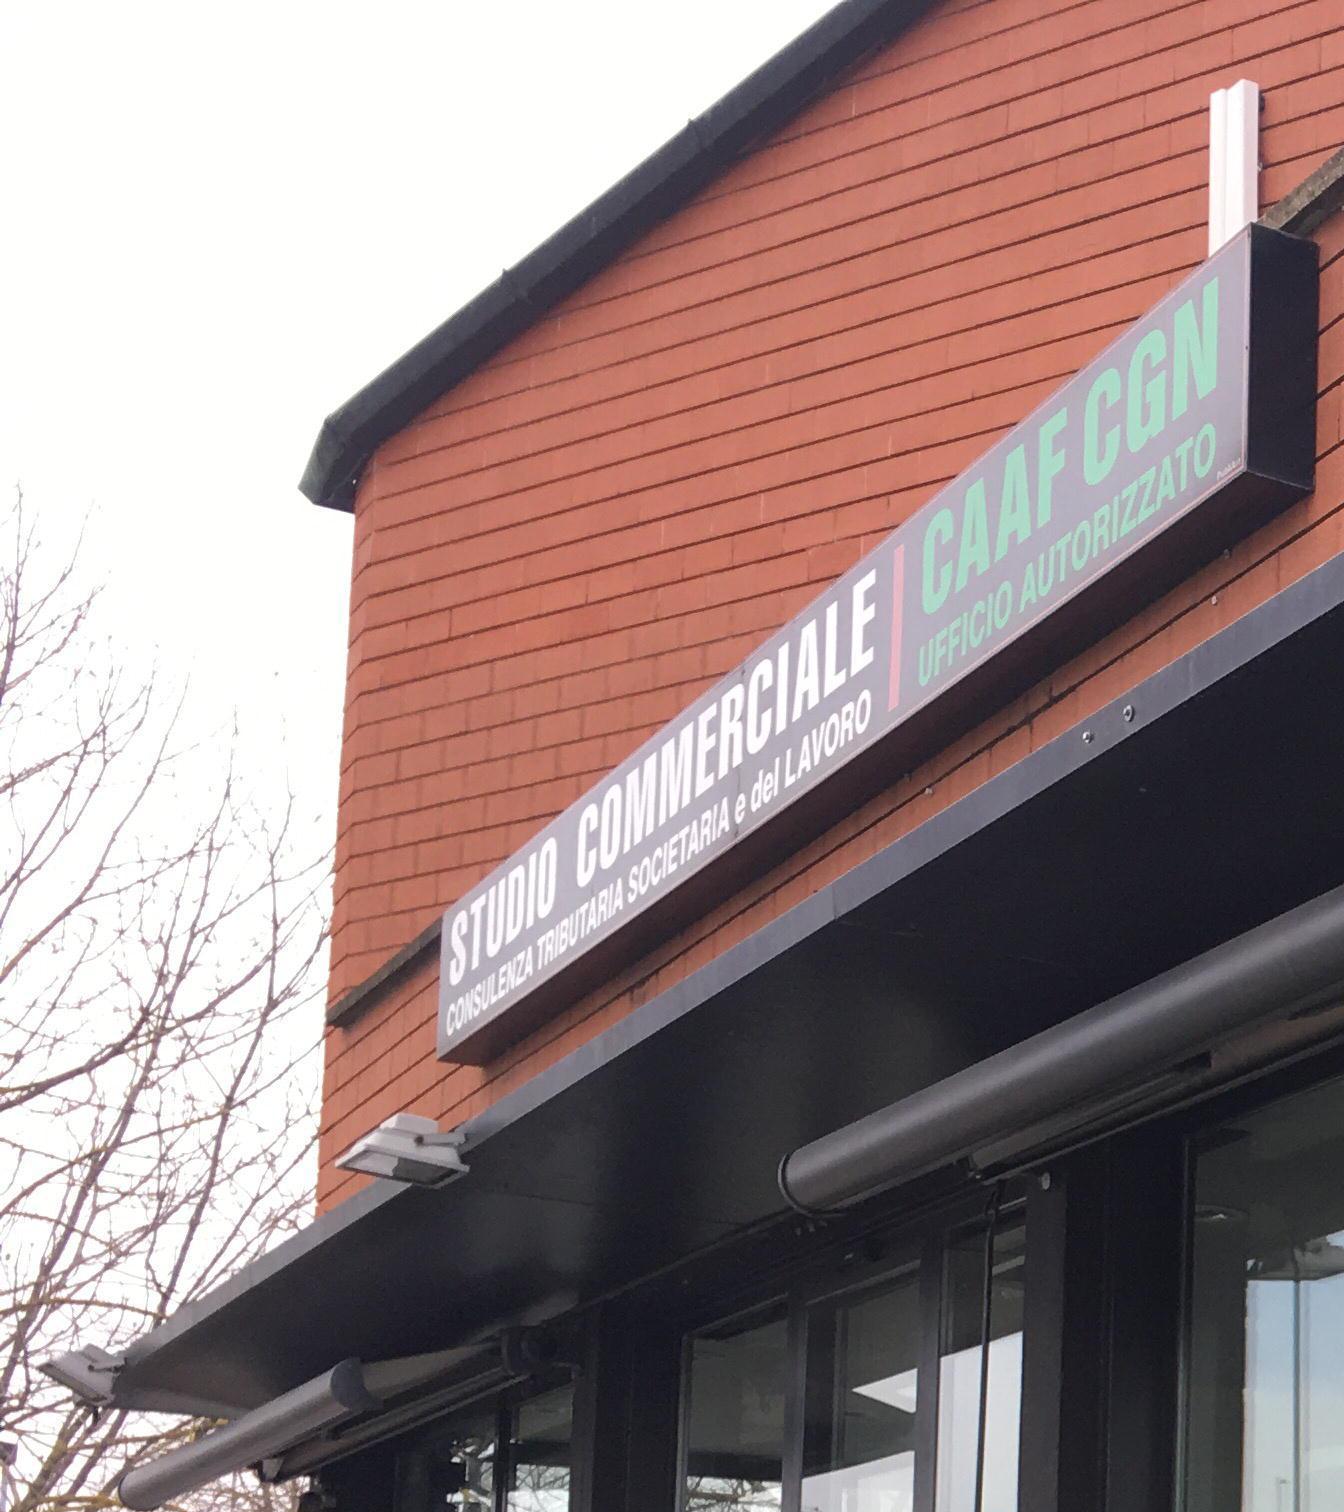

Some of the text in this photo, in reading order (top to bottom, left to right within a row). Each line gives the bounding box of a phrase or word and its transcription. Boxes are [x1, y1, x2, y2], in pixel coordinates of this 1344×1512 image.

[918, 423, 1216, 687] UFFICIO AUTORIZZATO
[921, 276, 1219, 615] CAAF CGN
[446, 689, 872, 1036] CONSULENZA TRIBUTARIA SOCIETARIA e del LAVORO
[449, 568, 877, 987] STUDIO COMMERCIALE
